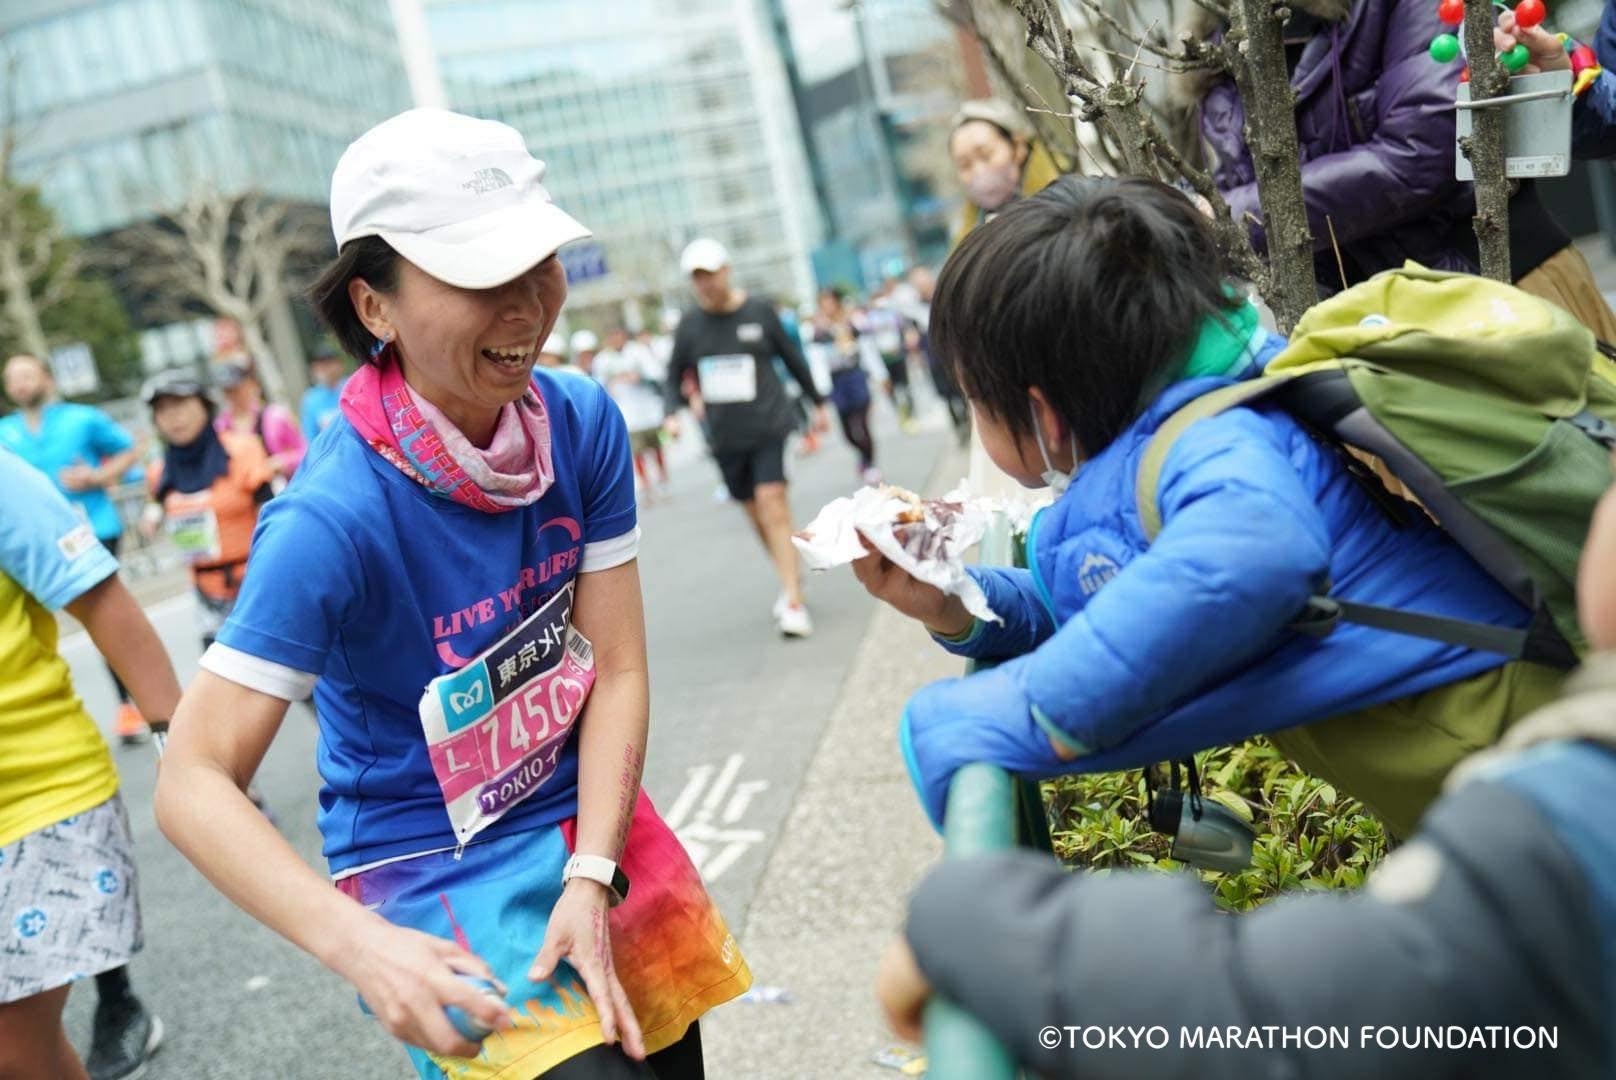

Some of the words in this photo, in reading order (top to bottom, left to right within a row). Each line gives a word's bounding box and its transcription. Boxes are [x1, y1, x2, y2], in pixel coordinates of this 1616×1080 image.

[433, 597, 496, 639] LIVE
[498, 568, 536, 613] YOR
[539, 546, 580, 584] LIFE
[445, 747, 471, 773] L
[482, 757, 543, 810] TOKIO
